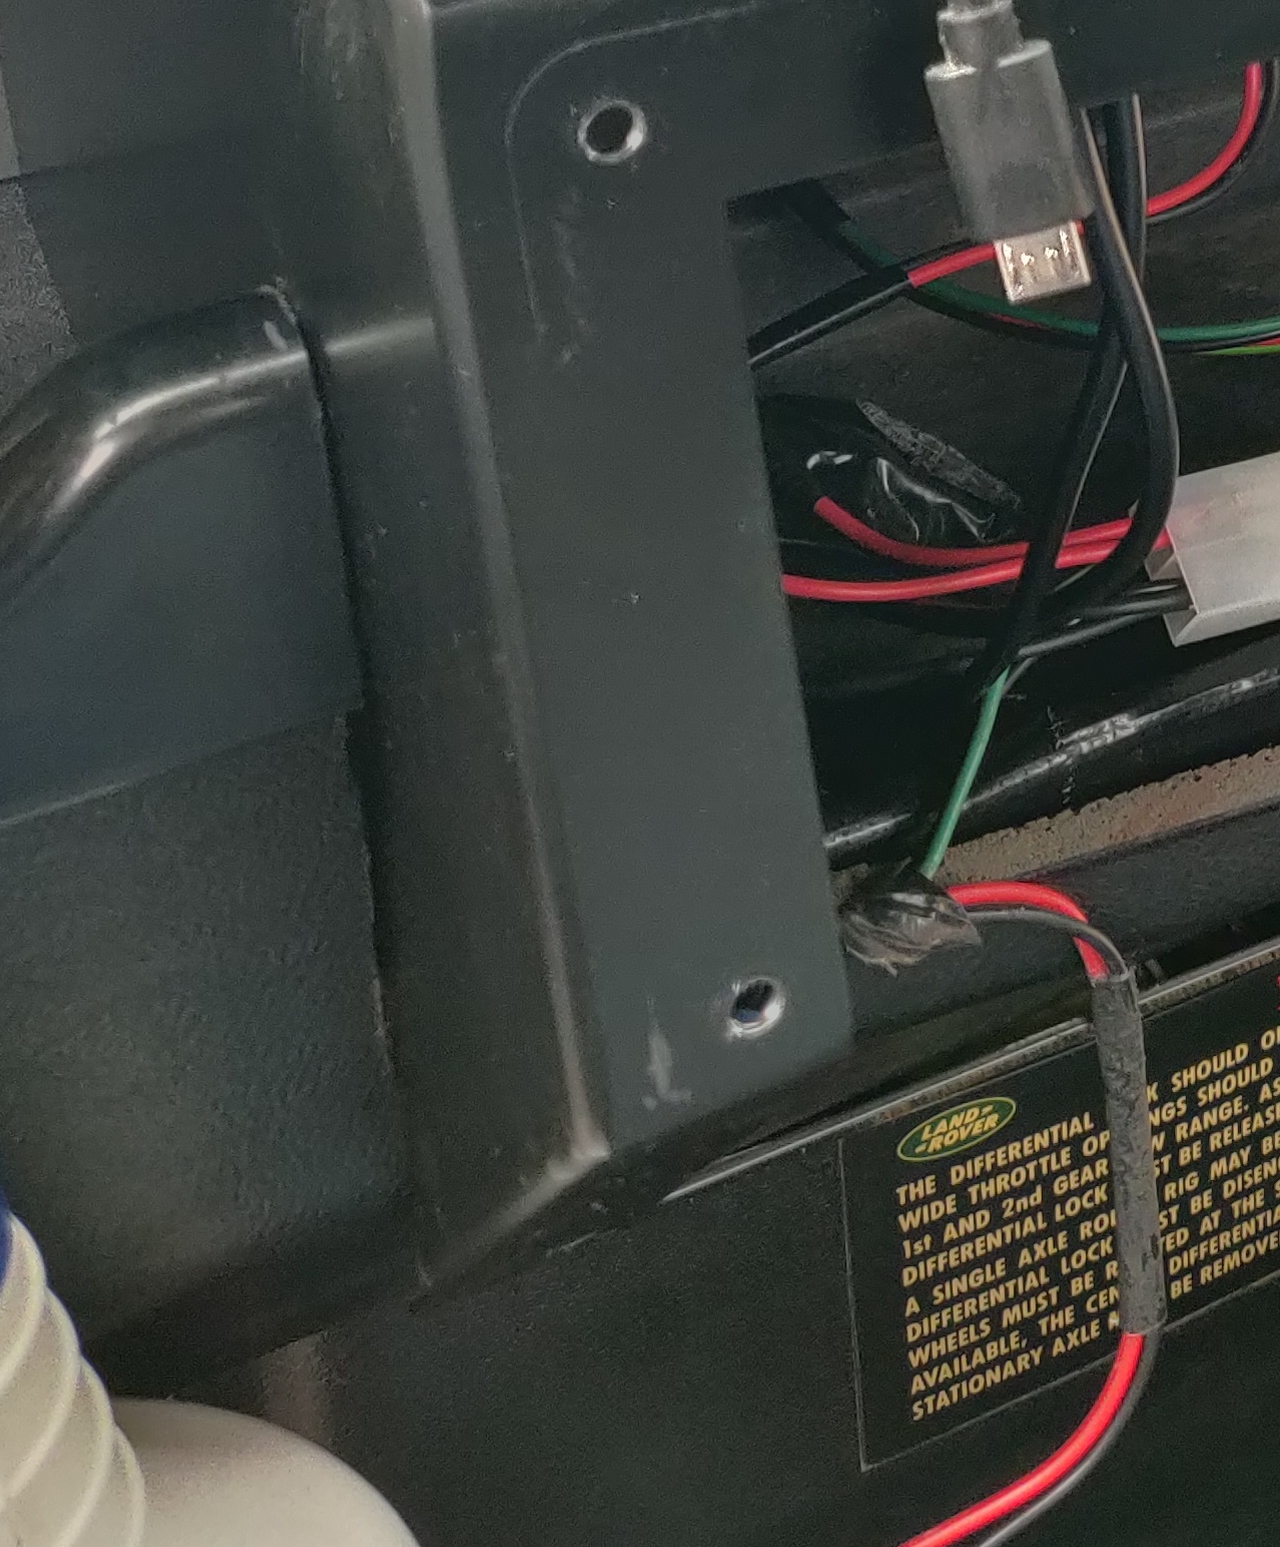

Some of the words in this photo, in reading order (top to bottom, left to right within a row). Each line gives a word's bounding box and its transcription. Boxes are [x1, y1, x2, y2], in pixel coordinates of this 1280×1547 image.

[896, 1174, 937, 1205] THE
[950, 1111, 1093, 1185] DIFFERENTIAL
[1171, 1042, 1249, 1092] SHOULD
[898, 1193, 957, 1232] WIDE
[968, 1146, 1072, 1204] THROTTLE
[1082, 1095, 1188, 1156] OPNGS
[1197, 1056, 1274, 1106] SHOULD
[903, 1233, 933, 1259] 1st
[943, 1208, 991, 1243] AND
[1002, 1184, 1043, 1218] 2nd
[1053, 1157, 1109, 1196] GEAR
[1175, 1095, 1249, 1142] RANGE.
[902, 1211, 1048, 1286] DIFFERENTIAL
[1055, 1182, 1109, 1222] LOCK
[1179, 1139, 1202, 1166] BE
[905, 1295, 921, 1317] A
[933, 1258, 1007, 1305] SINGLE
[1018, 1231, 1069, 1268] AXLE
[1164, 1170, 1200, 1202] RIG
[1210, 1146, 1251, 1180] MAY
[907, 1266, 1050, 1342] DIFFERENTIAL
[1061, 1235, 1114, 1275] LOCK
[1190, 1188, 1213, 1215] BE
[908, 1318, 992, 1368] WHEELS
[1002, 1285, 1060, 1328] MUST
[1071, 1269, 1095, 1296] BE
[1200, 1209, 1222, 1236] AT
[1231, 1187, 1265, 1218] THE
[911, 1330, 1026, 1395] AVAILABLE,
[1038, 1305, 1075, 1336] THE
[913, 1346, 1043, 1420] STATIONARY
[1052, 1318, 1101, 1357] AXLE
[1170, 1273, 1193, 1299] BE
